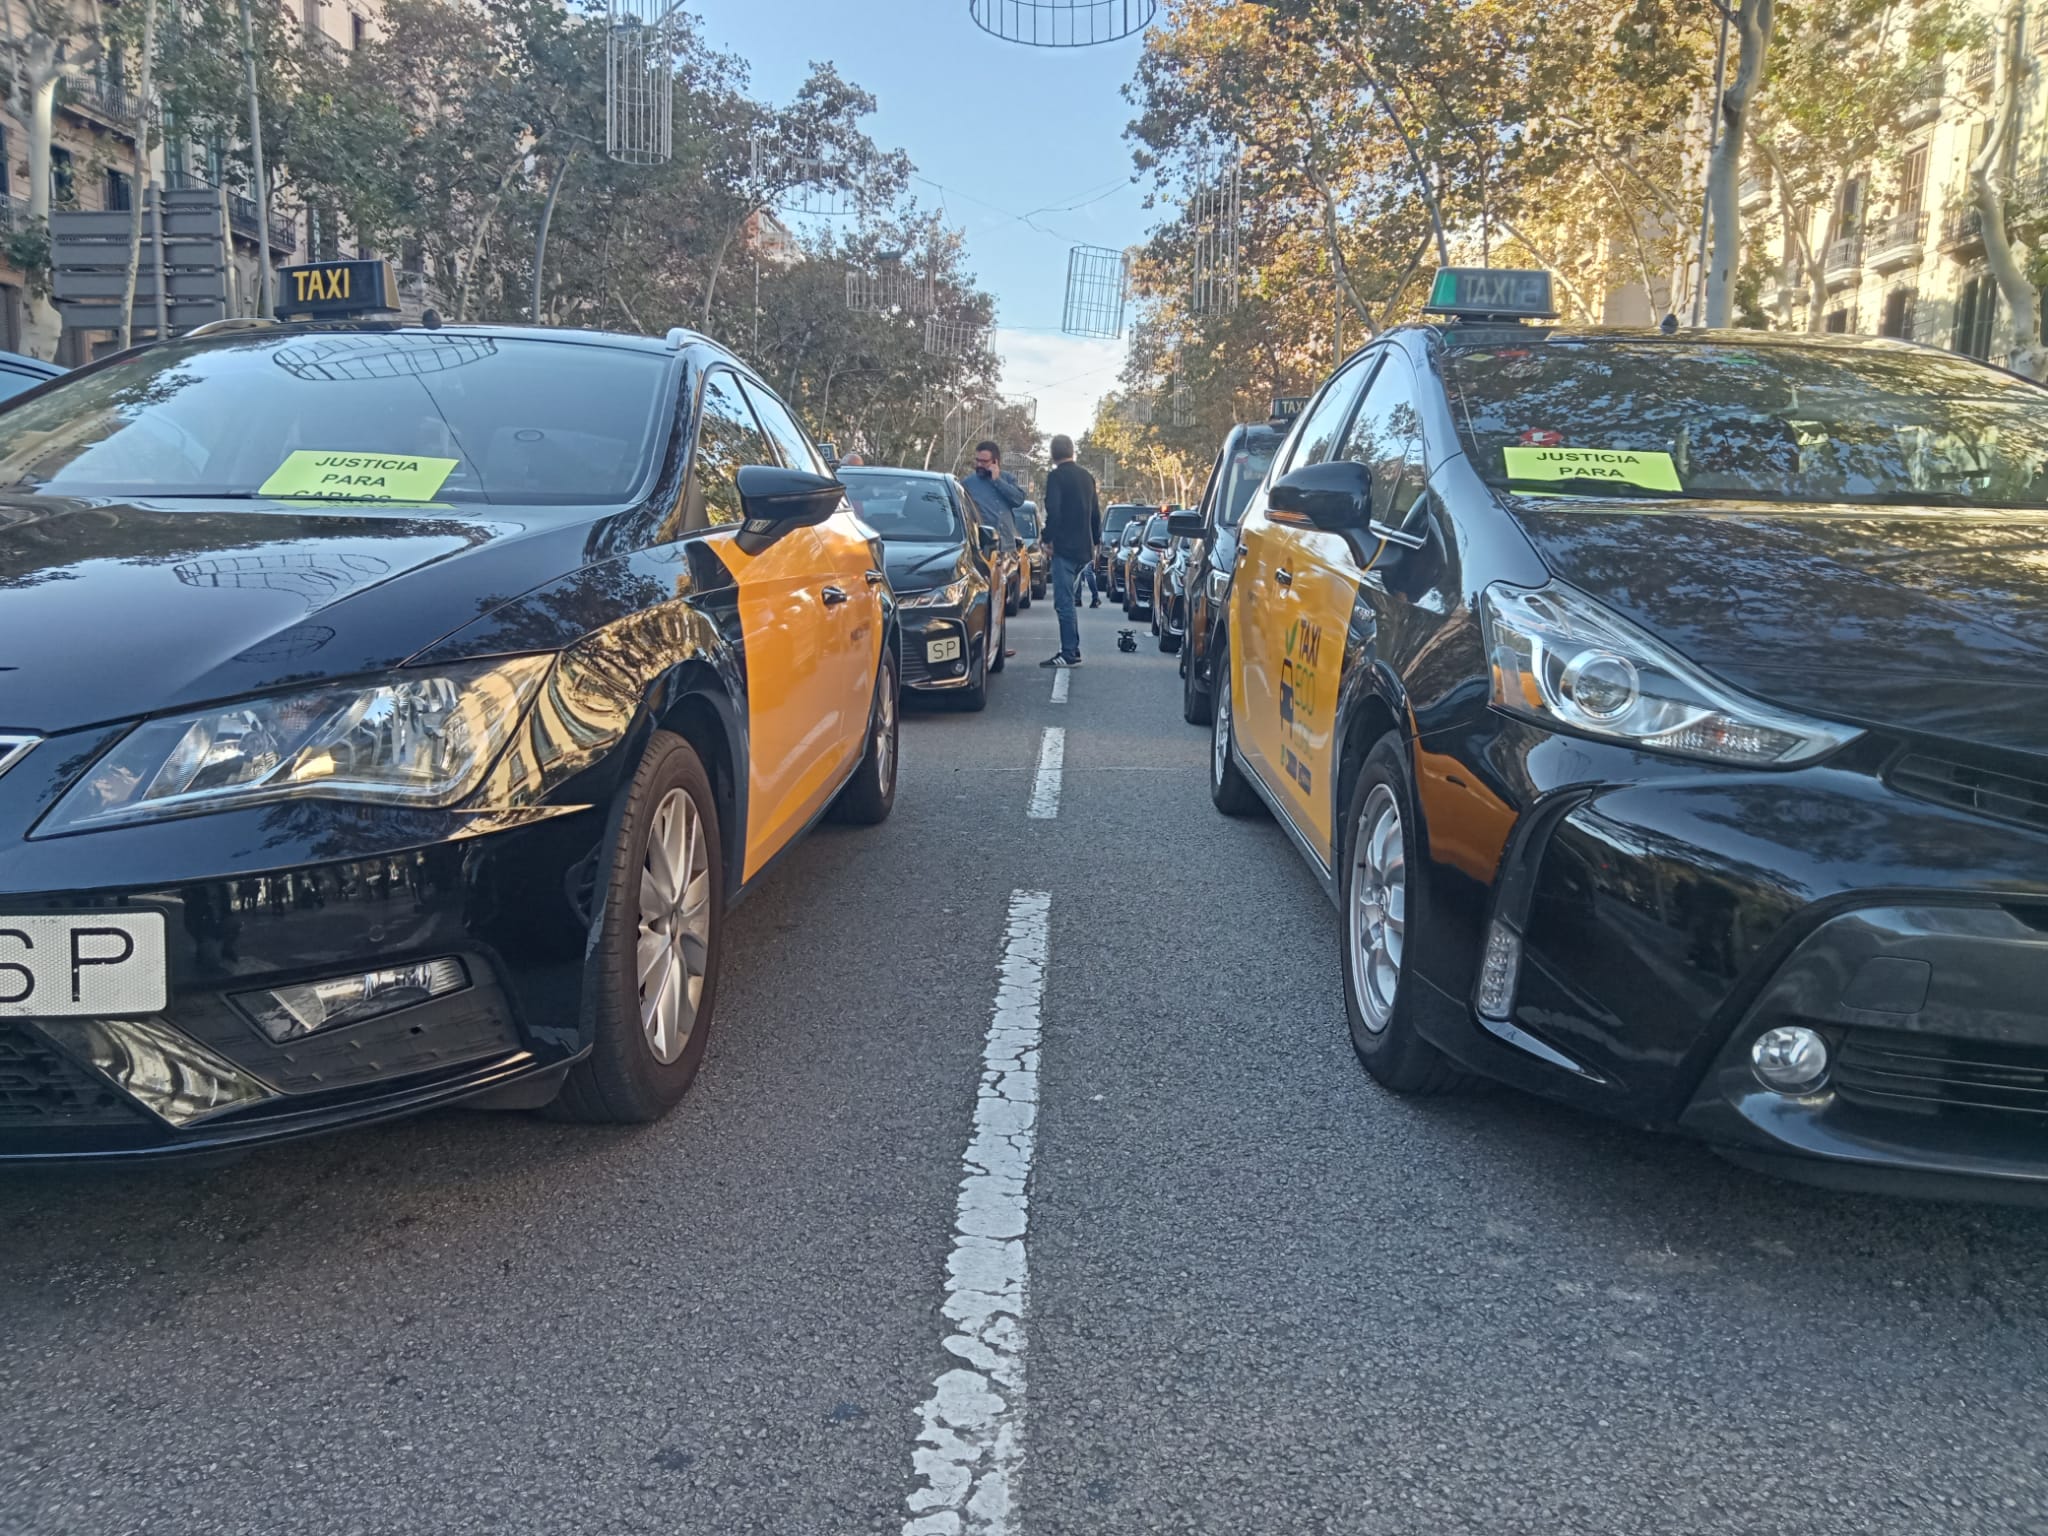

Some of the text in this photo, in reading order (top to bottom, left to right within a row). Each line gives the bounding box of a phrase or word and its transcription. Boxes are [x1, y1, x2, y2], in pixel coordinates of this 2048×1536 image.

[292, 268, 350, 302] TAXI
[1463, 275, 1515, 305] TAXI
[314, 456, 419, 472] JUSTICIA
[1536, 452, 1641, 465] JUSTICIA
[320, 473, 386, 488] PARA
[1559, 467, 1625, 478] PARA
[932, 640, 956, 660] SP
[1299, 619, 1322, 667] TAXI
